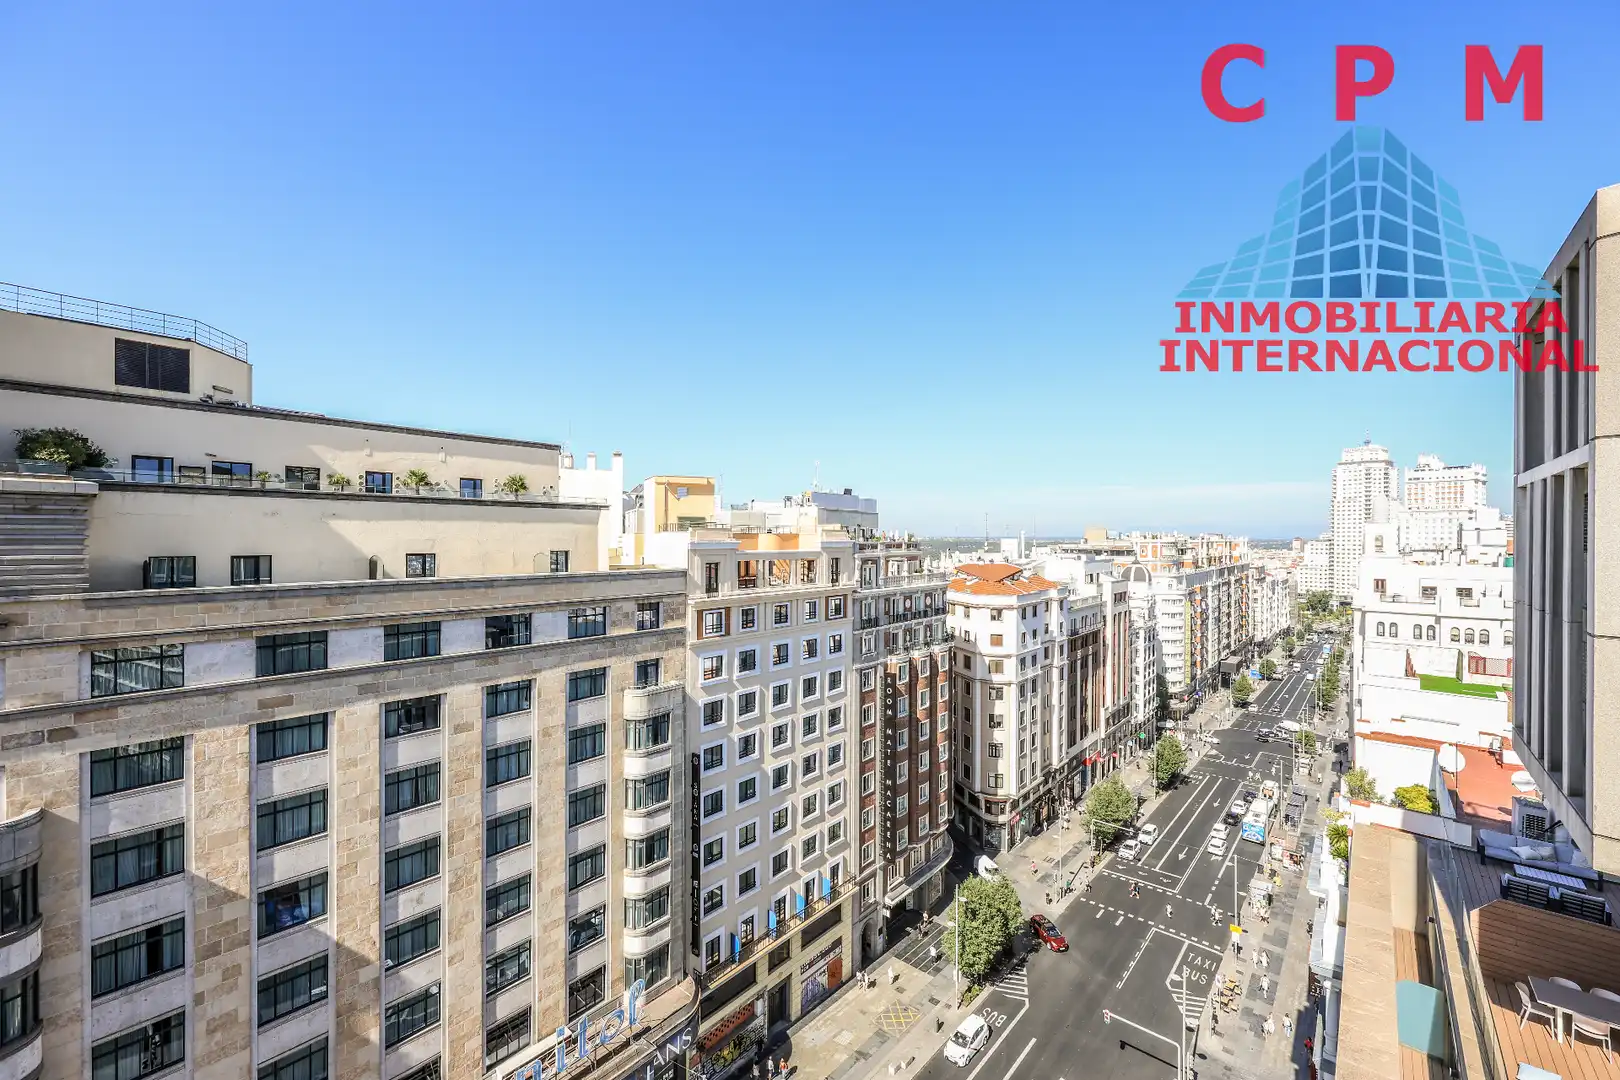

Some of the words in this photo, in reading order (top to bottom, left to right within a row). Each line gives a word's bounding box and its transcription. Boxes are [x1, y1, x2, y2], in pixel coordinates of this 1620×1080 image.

[1187, 952, 1217, 972] TAXI
[1182, 966, 1208, 985] BUS
[979, 1007, 1008, 1028] BUS
